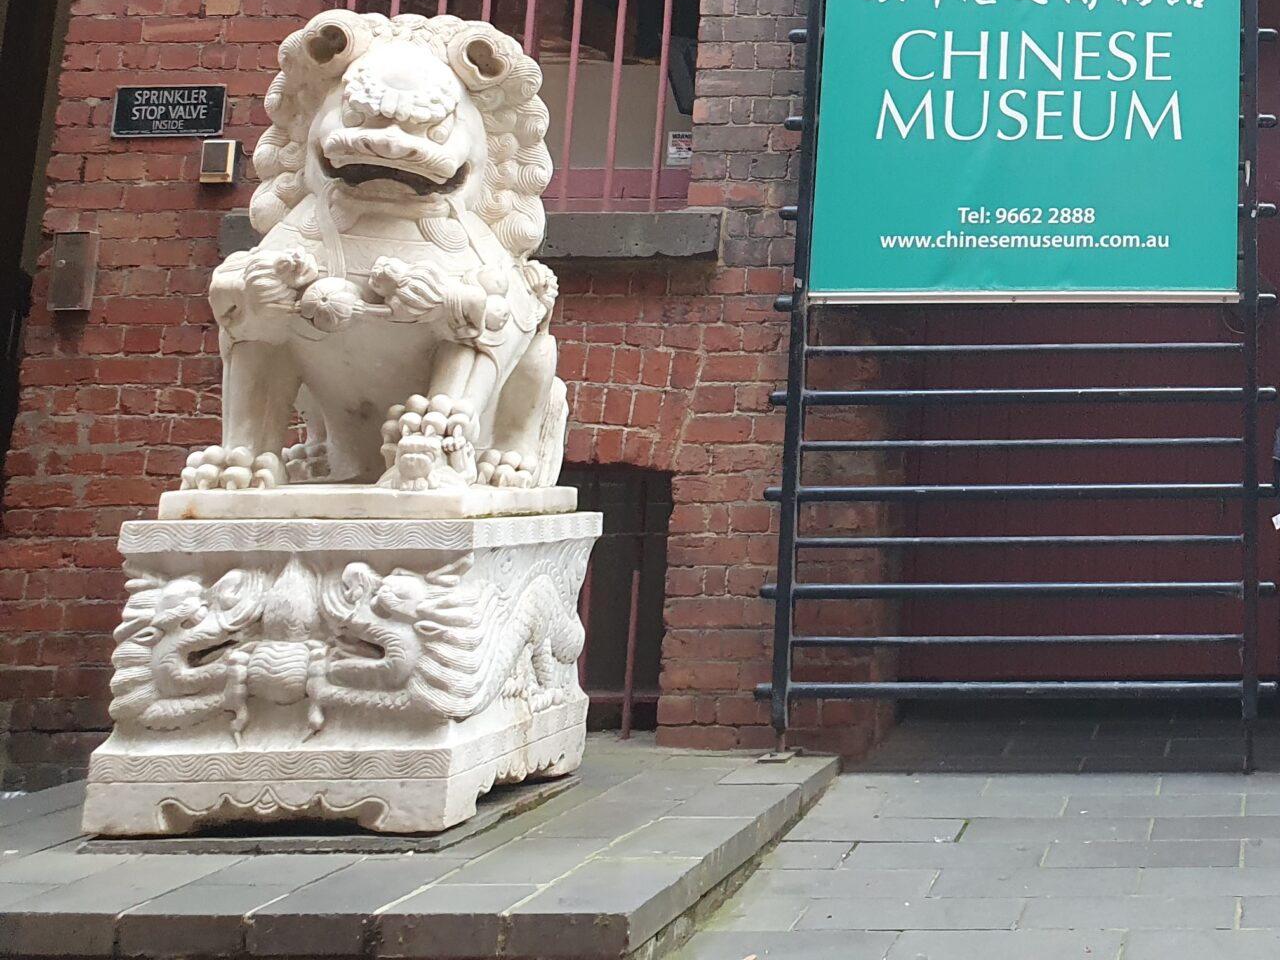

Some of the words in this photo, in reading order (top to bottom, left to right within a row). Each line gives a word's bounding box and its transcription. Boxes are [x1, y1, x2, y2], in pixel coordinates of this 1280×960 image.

[891, 29, 1173, 82] CHINESE
[133, 89, 208, 105] SPRINKLER
[131, 105, 166, 120] STOP
[168, 105, 208, 119] VALVE
[875, 88, 1183, 142] MUSEUM
[152, 120, 185, 130] INSIDE
[957, 206, 991, 224] Tel:
[995, 207, 1043, 225] 9662
[1047, 207, 1096, 224] 2888
[880, 230, 1170, 249] www.chinesemuseum.com.au
